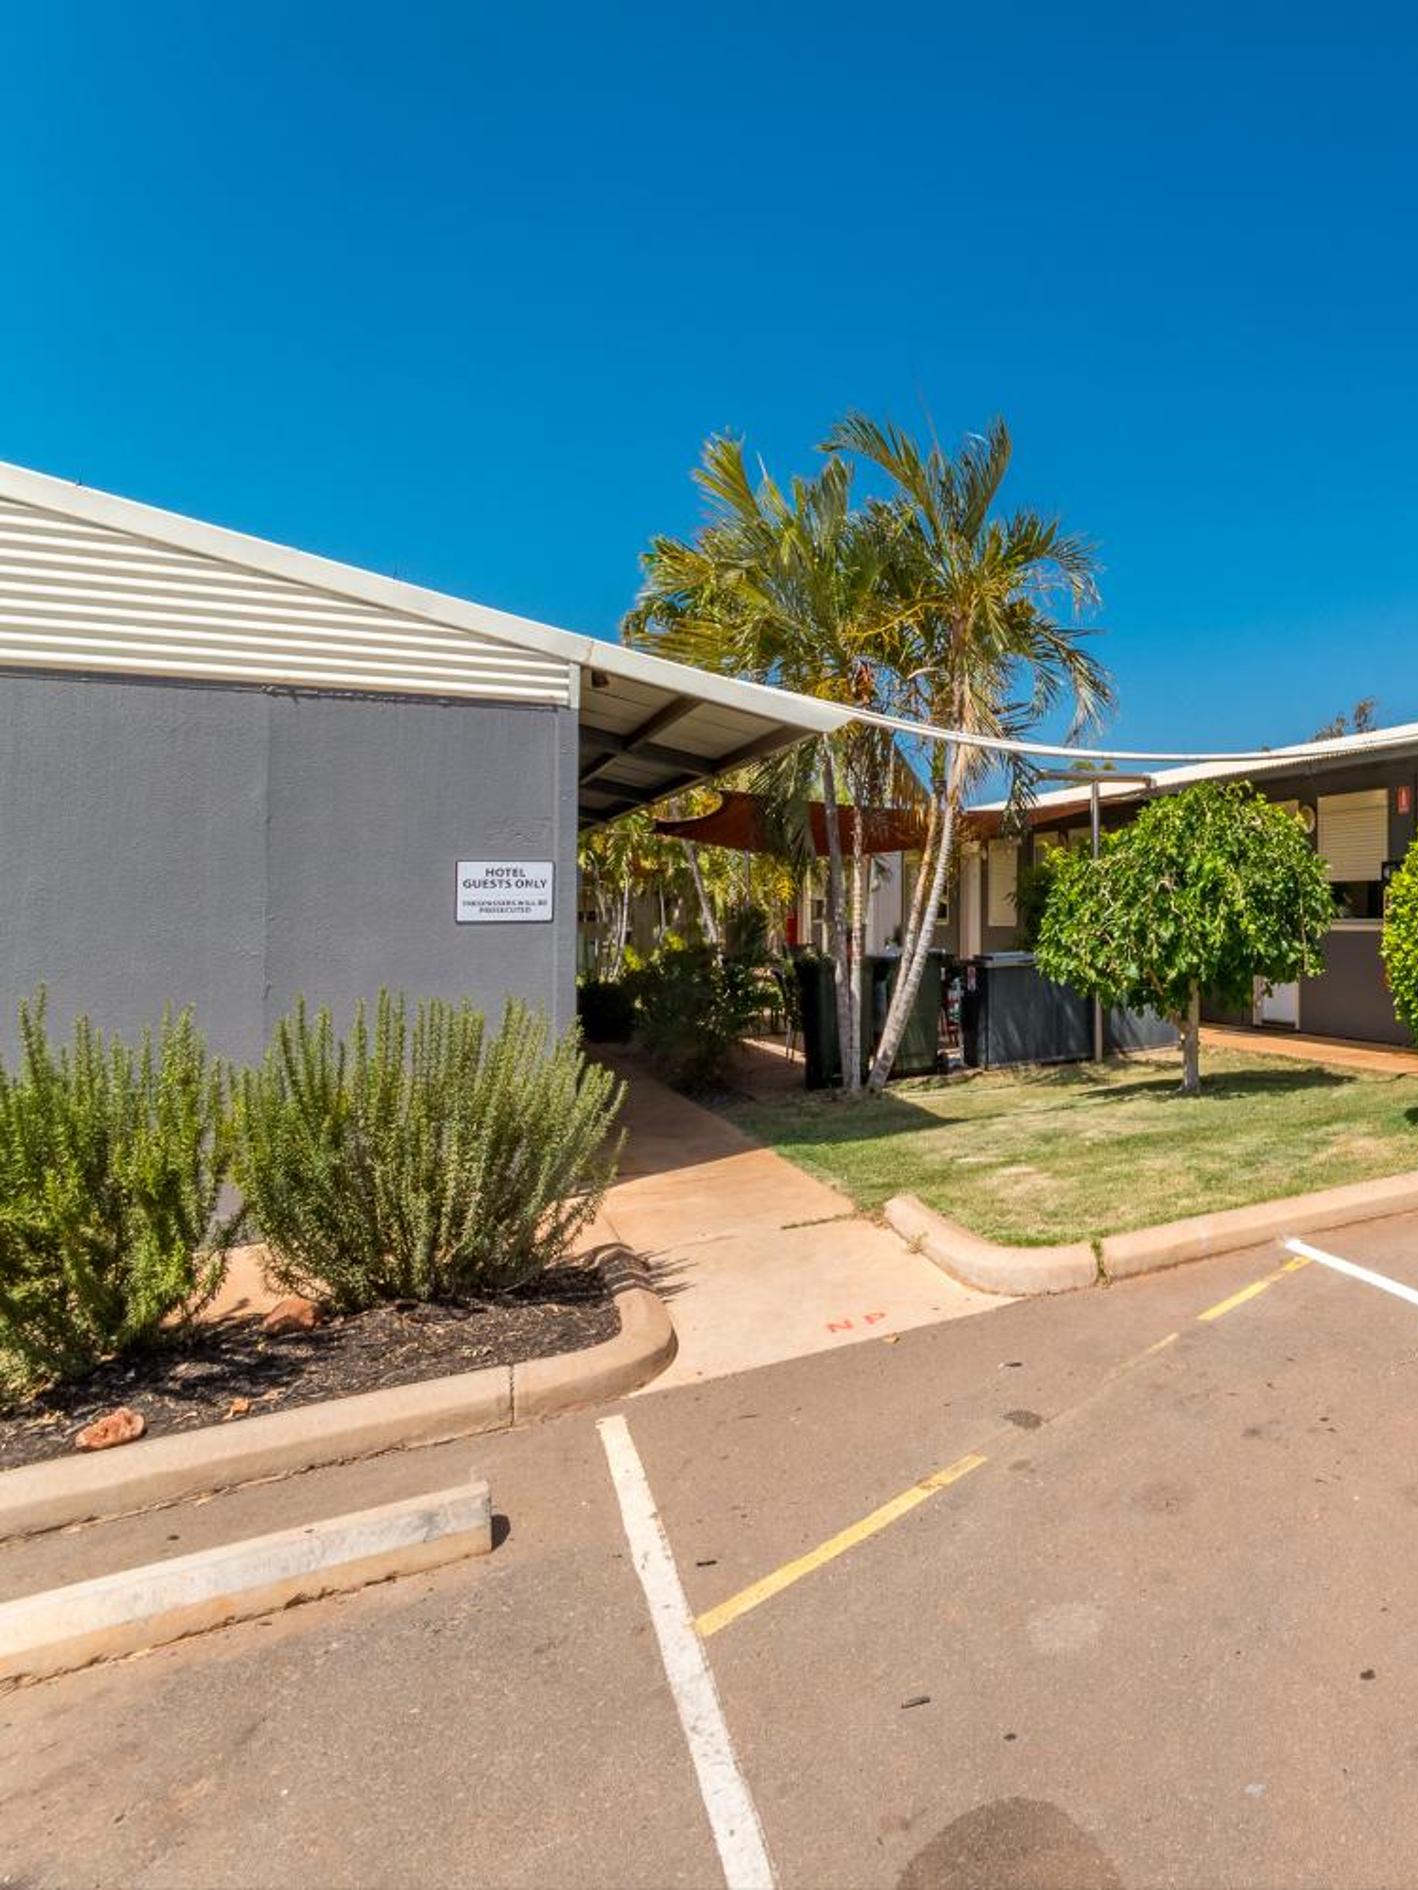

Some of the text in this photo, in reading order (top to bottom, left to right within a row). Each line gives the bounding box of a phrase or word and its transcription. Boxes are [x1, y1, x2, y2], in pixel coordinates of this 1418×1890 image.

[485, 867, 526, 878] HOTEL
[462, 879, 548, 889] GUESTS ONLY
